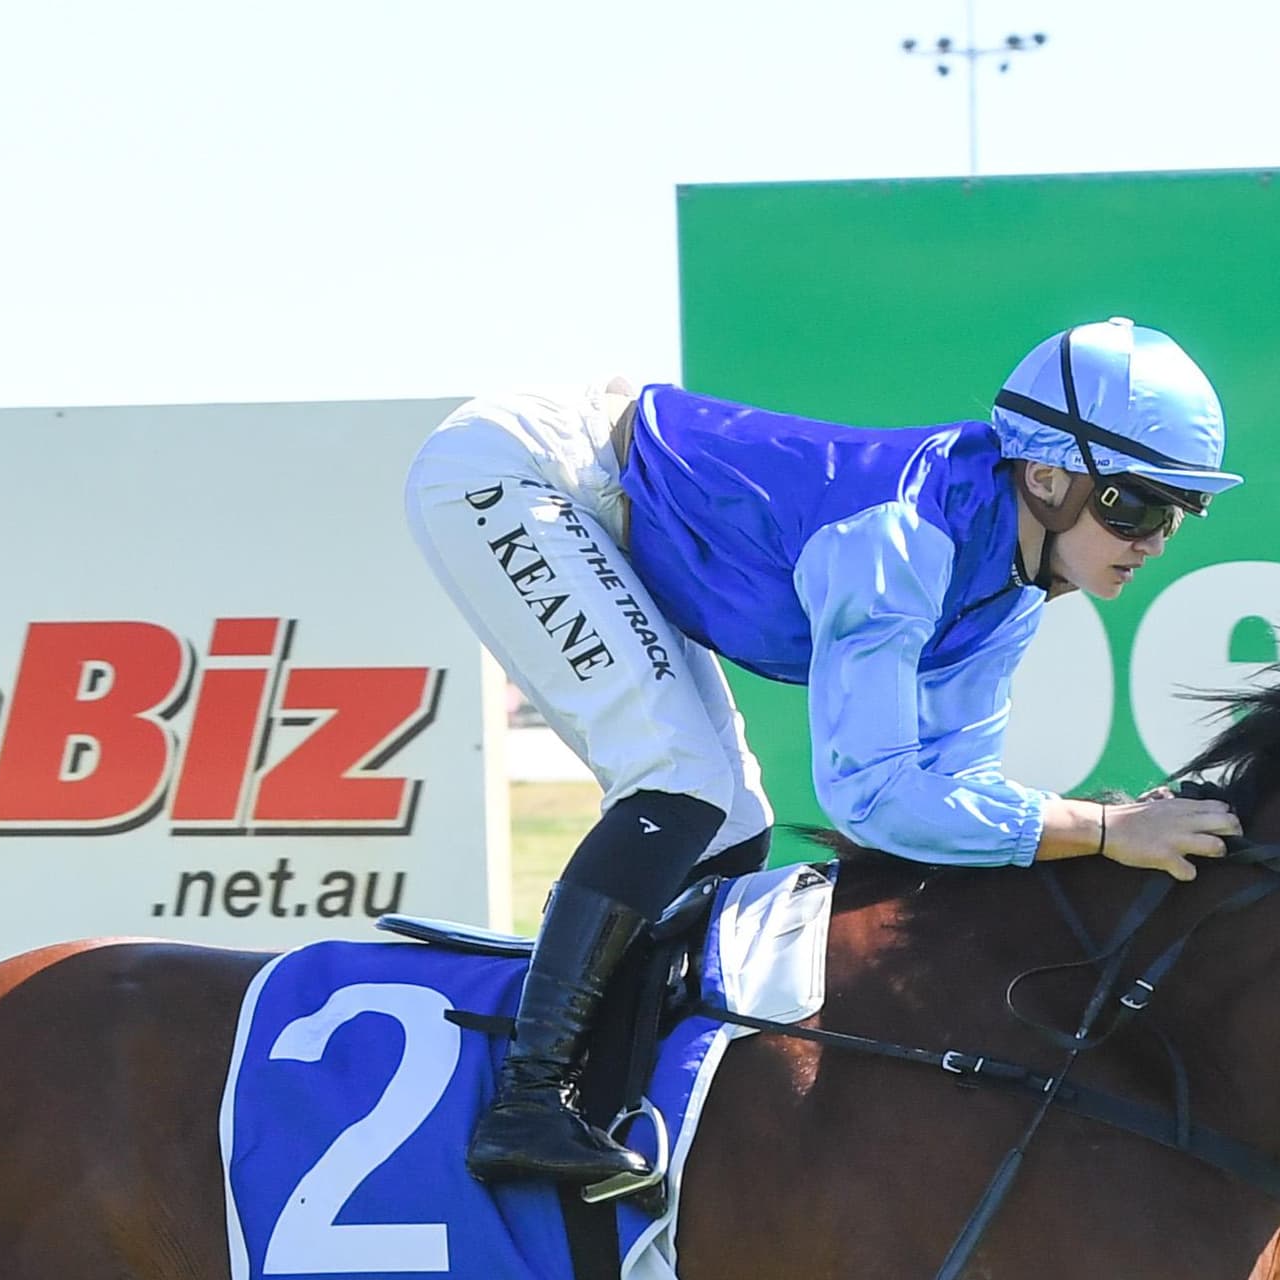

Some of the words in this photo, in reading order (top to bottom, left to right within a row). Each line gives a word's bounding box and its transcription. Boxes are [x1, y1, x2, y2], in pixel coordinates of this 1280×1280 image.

[465, 481, 504, 527] D.
[486, 523, 615, 682] KEANE
[579, 542, 626, 591] THE
[615, 593, 676, 681] TRACK
[151, 857, 407, 920] .net.au
[262, 982, 462, 1275] 2
